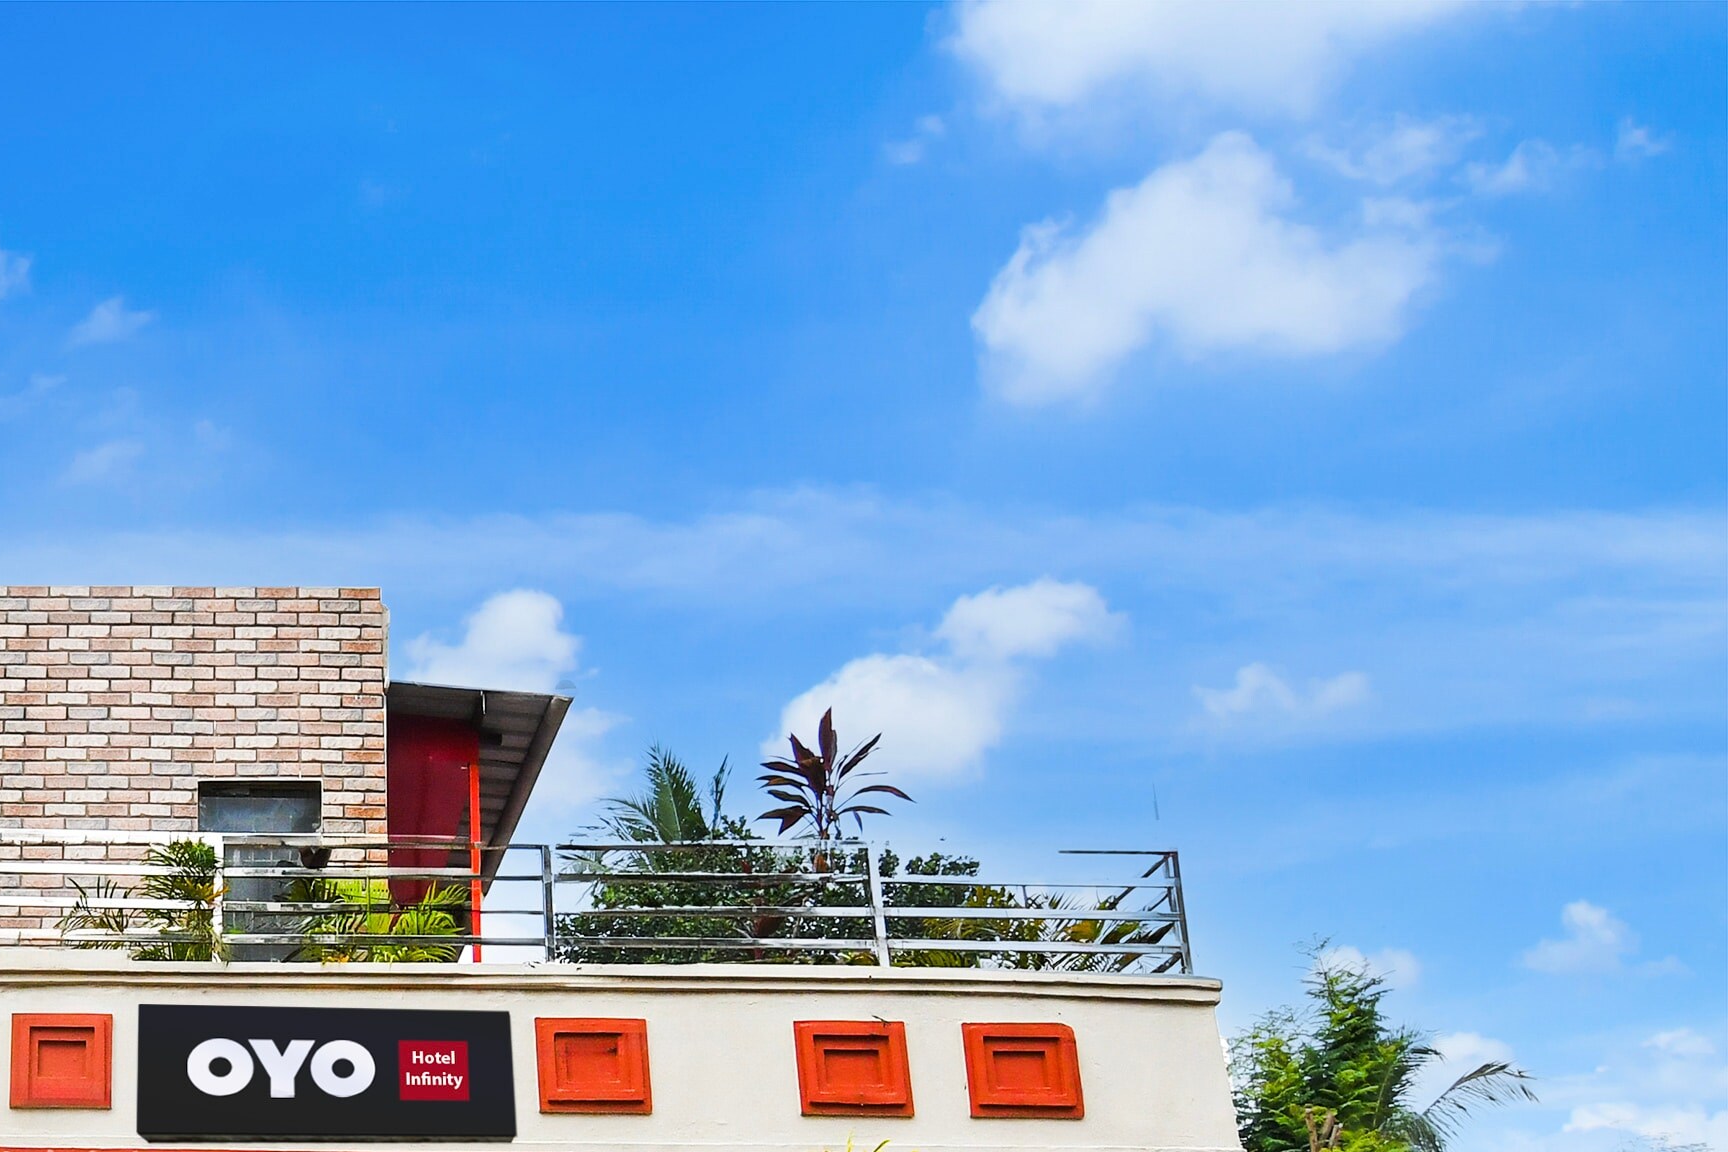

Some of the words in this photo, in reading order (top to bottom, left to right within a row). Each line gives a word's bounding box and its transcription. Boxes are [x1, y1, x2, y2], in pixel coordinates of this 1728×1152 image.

[411, 1050, 456, 1065] Hotel
[187, 1037, 376, 1099] OYO
[405, 1071, 463, 1089] Infinity
